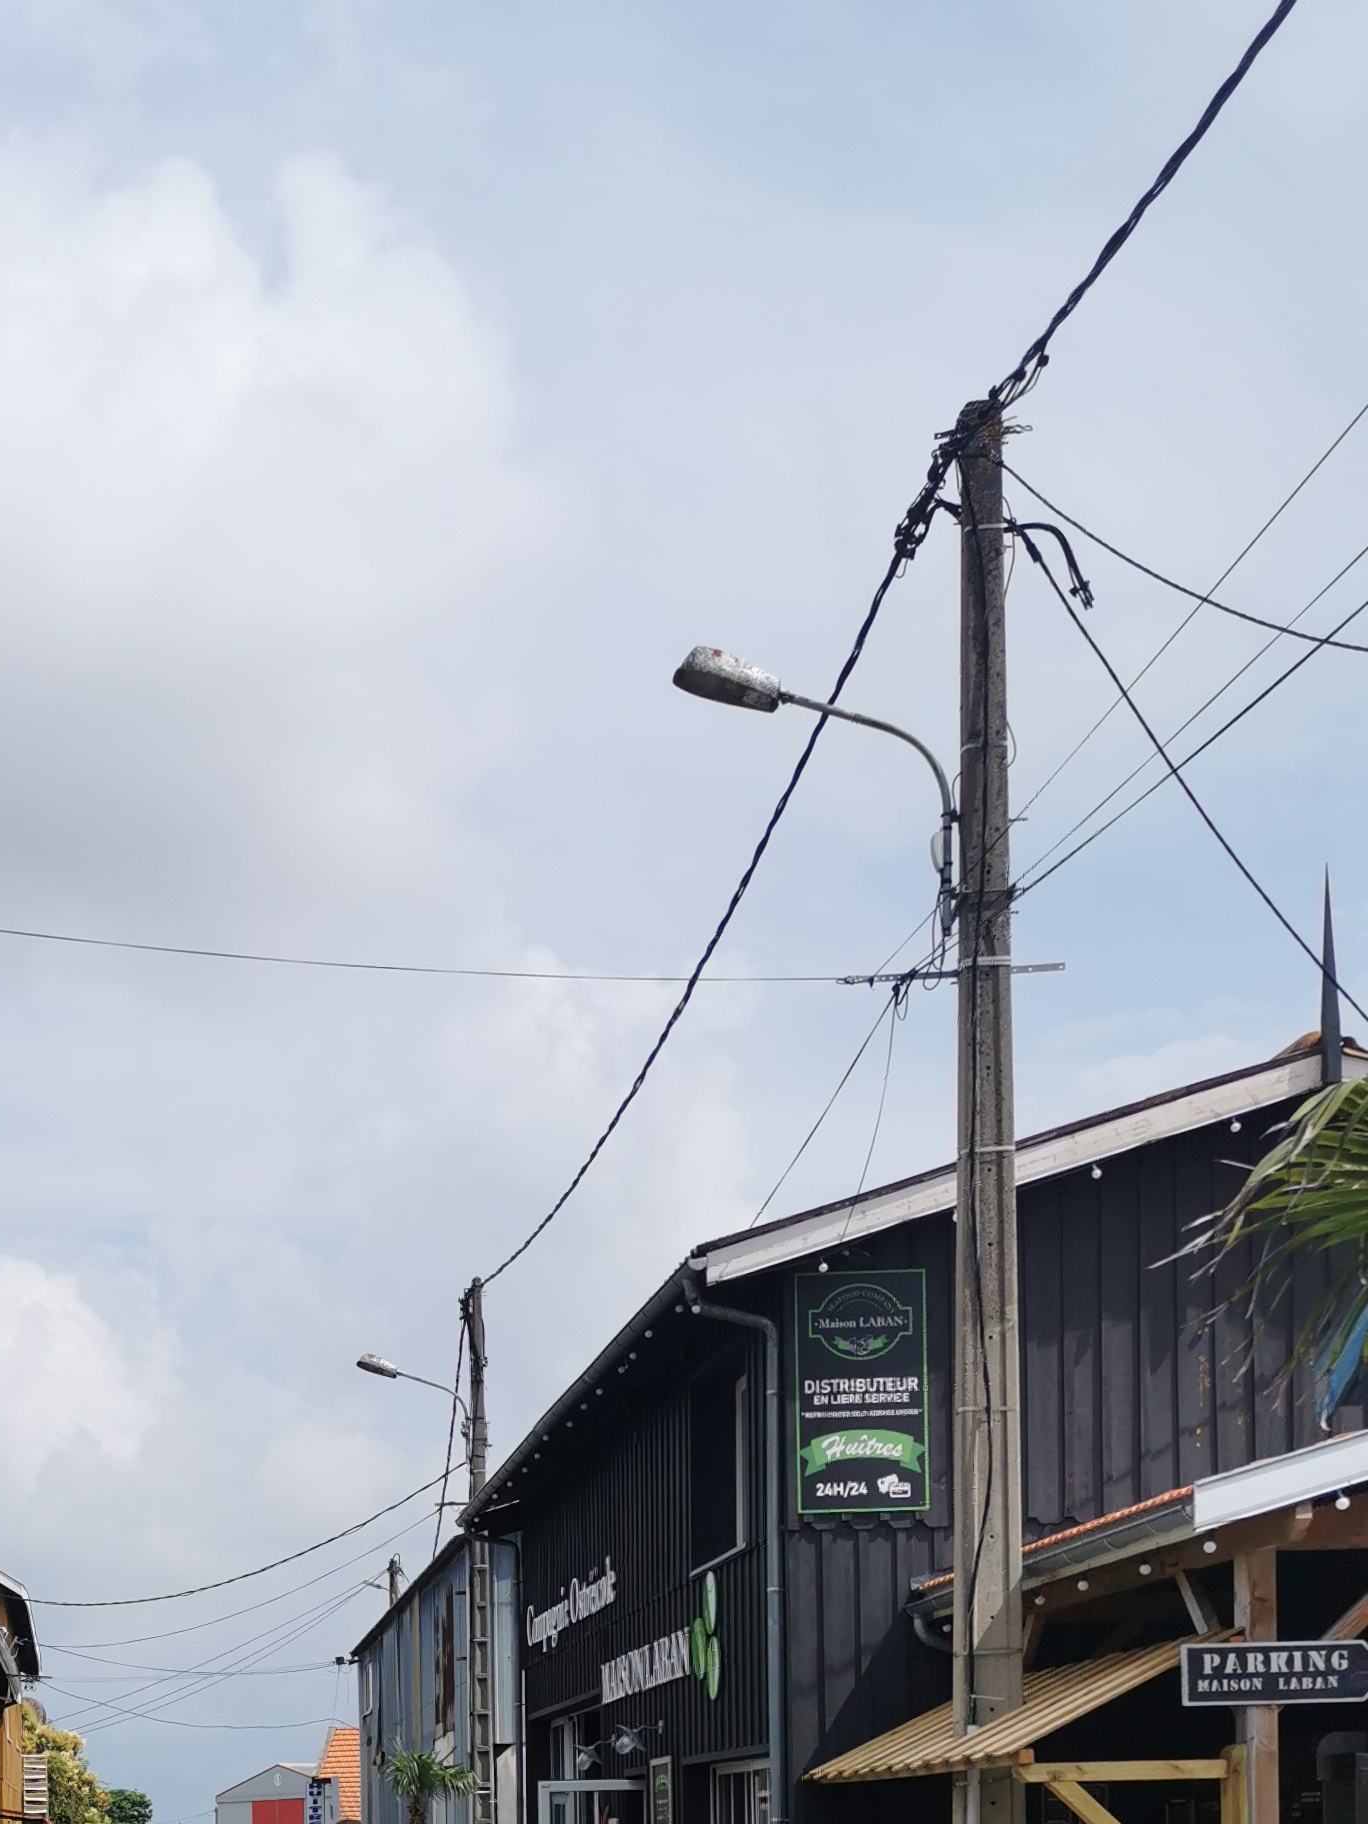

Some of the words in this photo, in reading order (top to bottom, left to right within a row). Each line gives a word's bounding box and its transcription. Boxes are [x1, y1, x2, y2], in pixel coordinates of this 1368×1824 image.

[818, 1318, 856, 1329] Maison
[860, 1315, 904, 1328] LABAN
[804, 1376, 919, 1394] DISTRIBUTEUR
[813, 1394, 829, 1405] EN
[821, 1434, 904, 1463] Huîtres
[815, 1481, 868, 1498] 24H/24
[1202, 1650, 1349, 1675] PARKING
[1197, 1677, 1262, 1692] MAISON
[1278, 1675, 1339, 1690] LABAN
